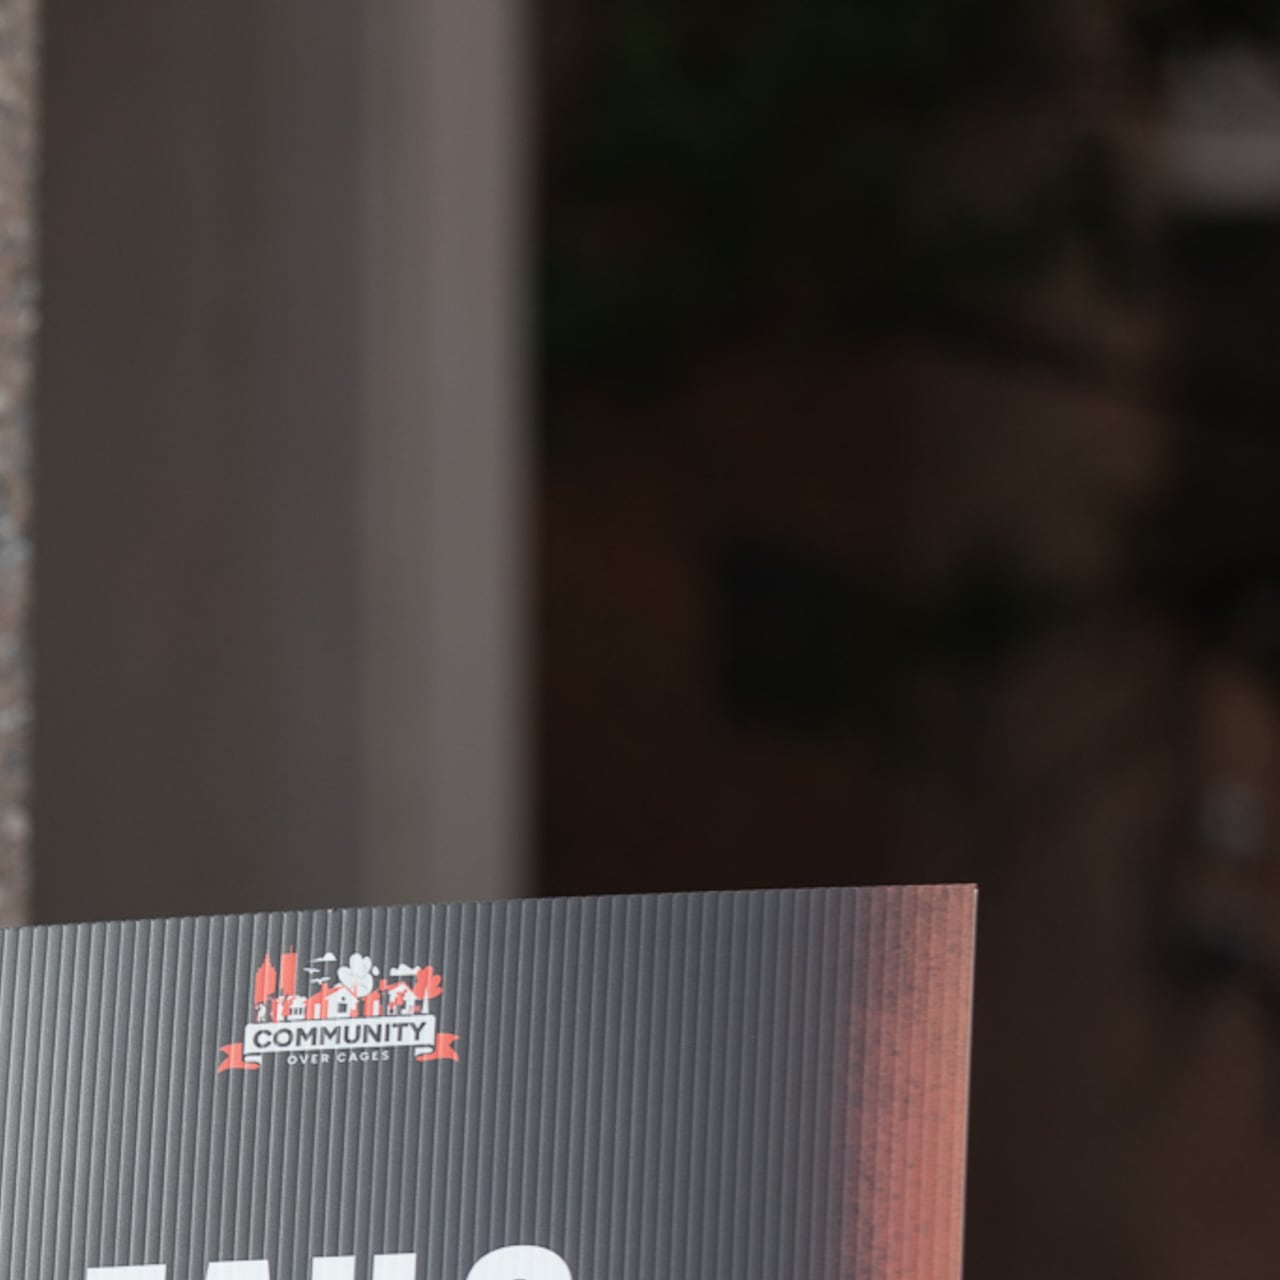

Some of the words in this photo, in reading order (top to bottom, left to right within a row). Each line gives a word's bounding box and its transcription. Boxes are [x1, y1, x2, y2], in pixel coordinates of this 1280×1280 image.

[252, 1021, 427, 1049] COMMUNITY
[286, 1053, 330, 1065] OVER
[335, 1050, 390, 1063] CAGES
